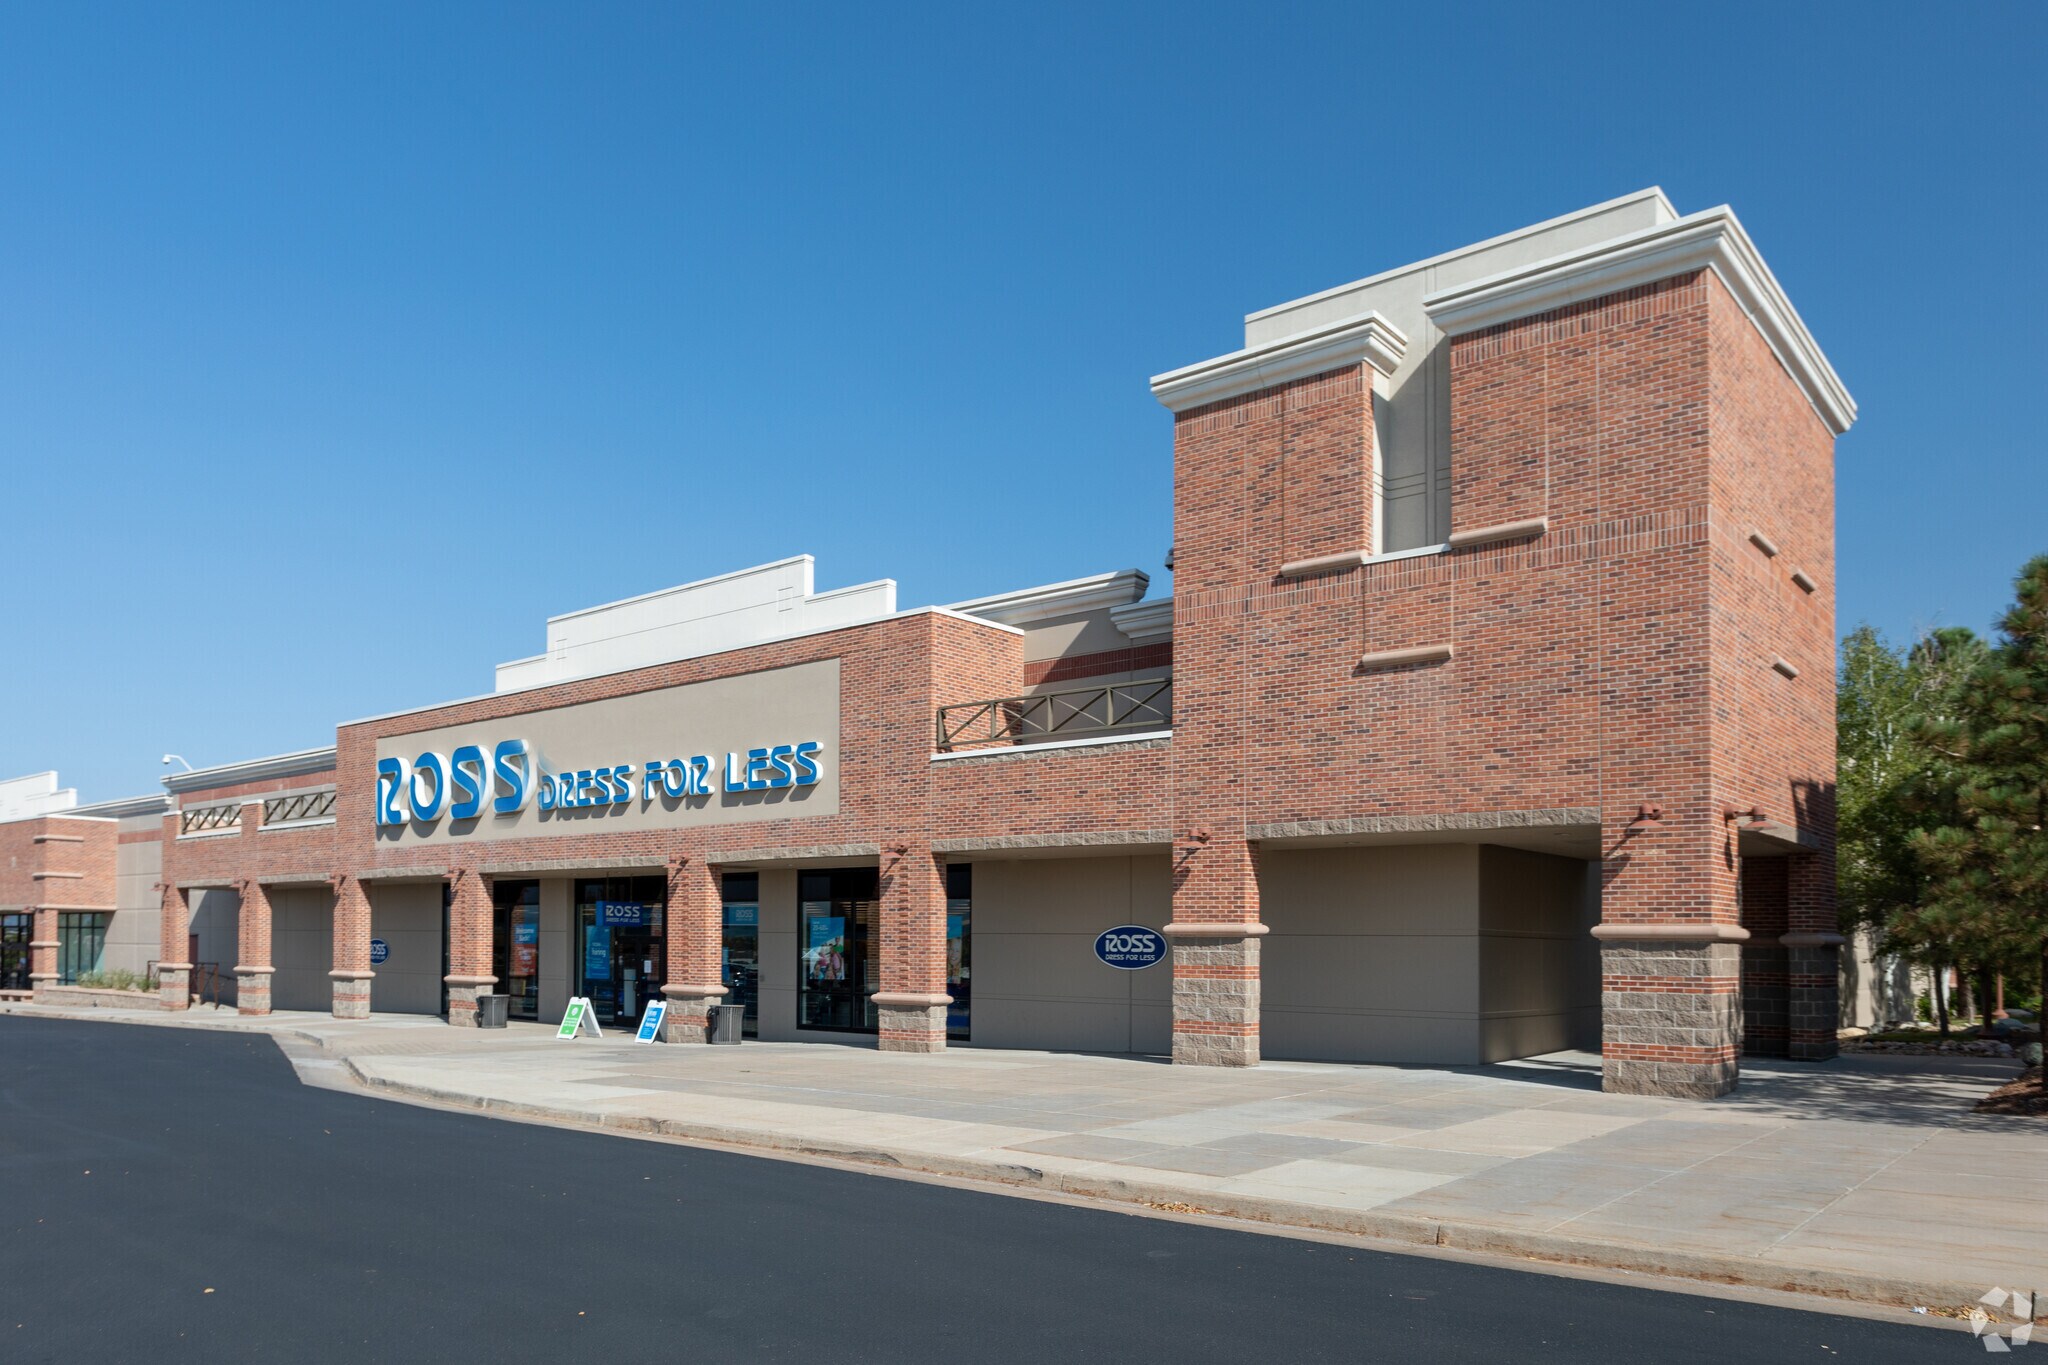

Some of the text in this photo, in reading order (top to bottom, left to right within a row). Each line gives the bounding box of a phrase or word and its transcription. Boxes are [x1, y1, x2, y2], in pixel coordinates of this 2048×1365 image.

[376, 739, 824, 826] ROSS DRESS FOR LESS
[605, 905, 641, 918] ROSS
[735, 909, 754, 918] ROSS
[370, 943, 386, 955] OSS
[1105, 934, 1156, 953] ROSS
